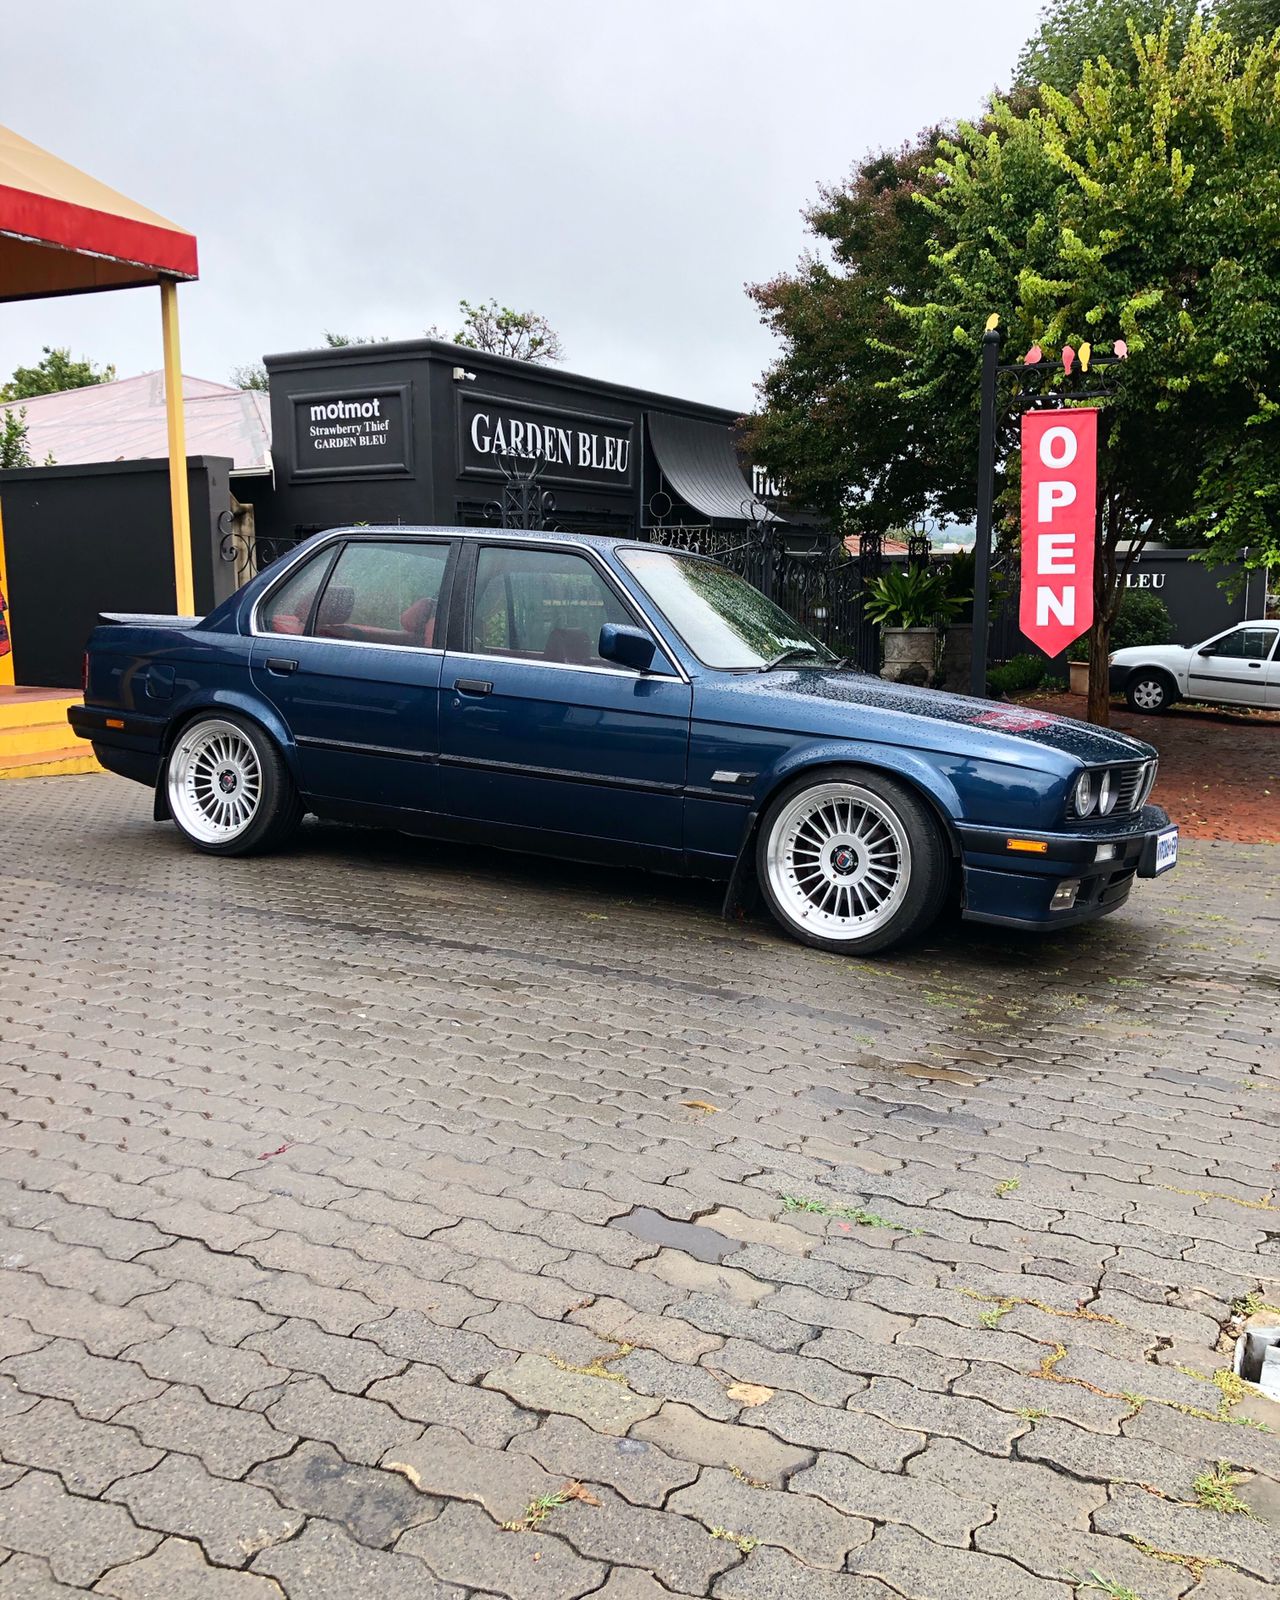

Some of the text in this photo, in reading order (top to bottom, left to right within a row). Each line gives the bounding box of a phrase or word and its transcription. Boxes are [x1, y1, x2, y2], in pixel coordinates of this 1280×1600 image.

[310, 398, 380, 421] motmot
[309, 419, 389, 436] Strawberry Thief
[314, 434, 387, 450] GARDEN BLEU
[471, 413, 630, 473] GARDEN BLEU
[1036, 426, 1078, 627] OPEN
